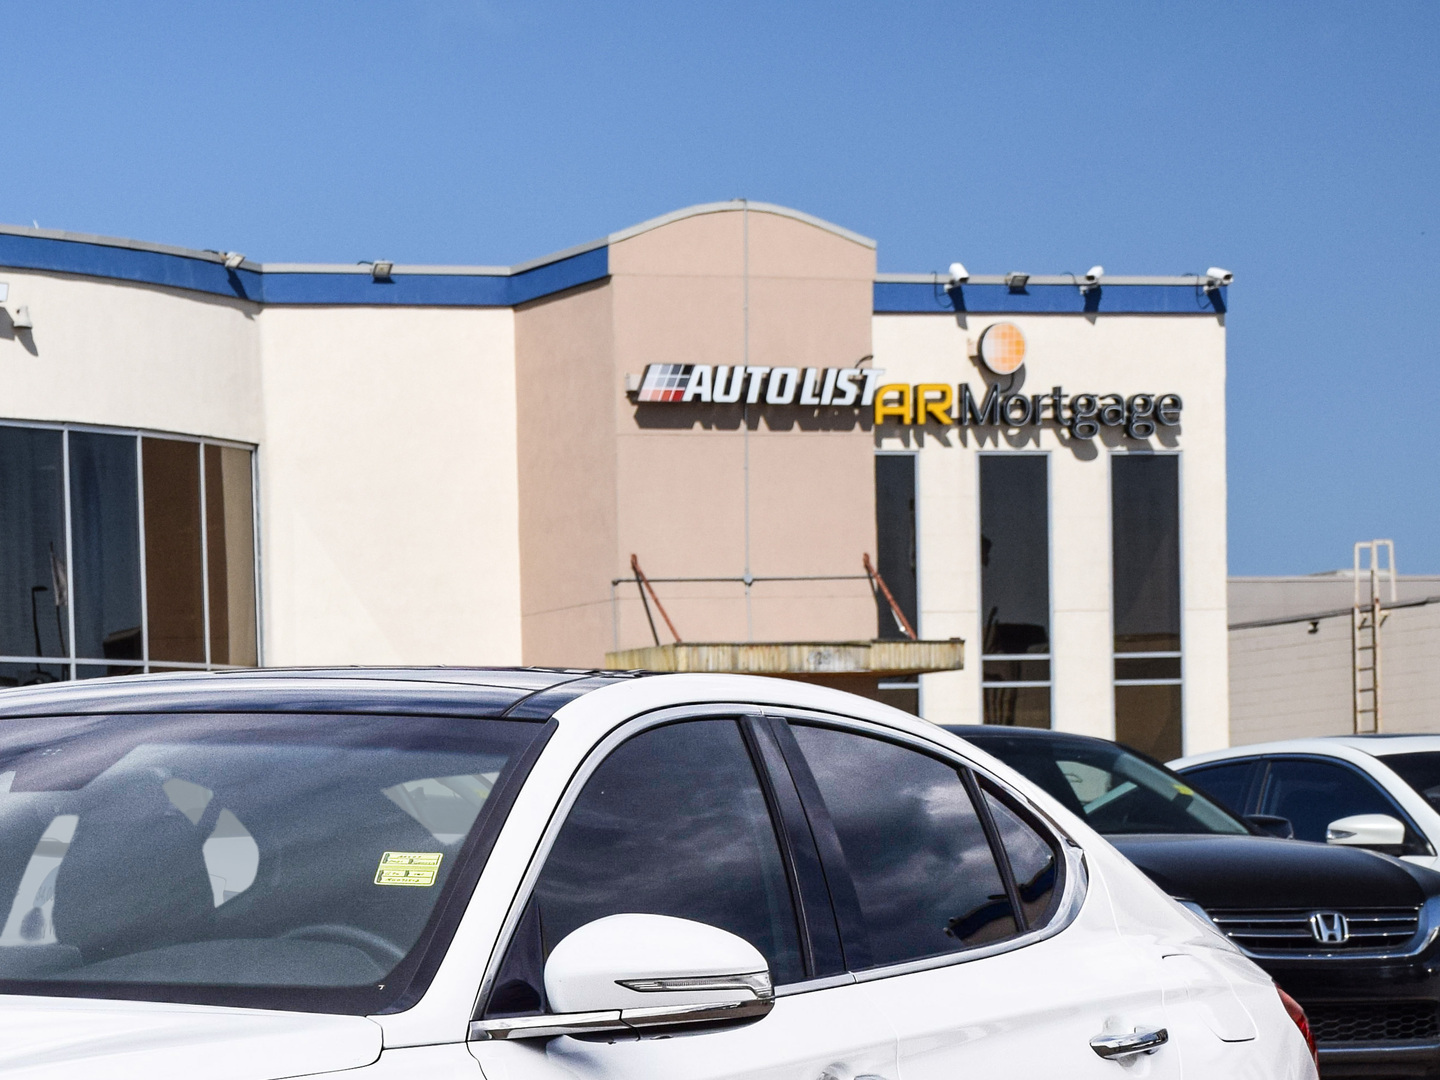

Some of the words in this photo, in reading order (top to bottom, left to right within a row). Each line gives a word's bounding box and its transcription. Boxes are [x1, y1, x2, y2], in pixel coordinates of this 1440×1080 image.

[681, 364, 799, 404] AUTO
[799, 367, 886, 406] LIST
[874, 383, 953, 425] AR
[958, 382, 1183, 440] Mortgage
